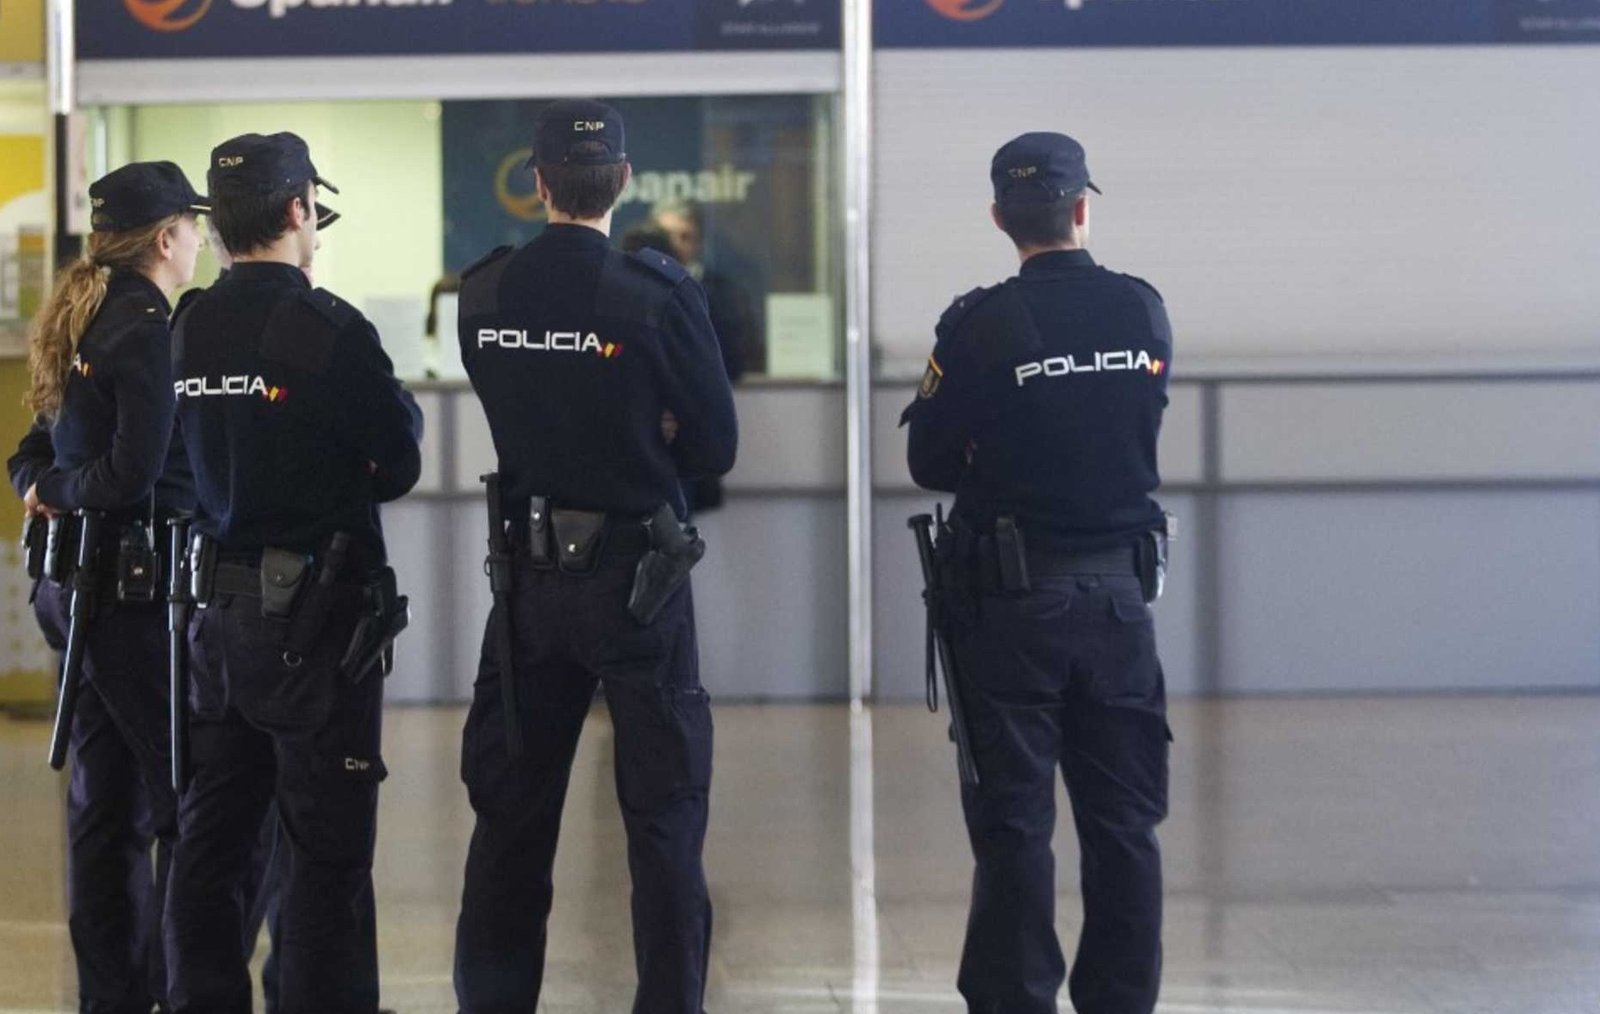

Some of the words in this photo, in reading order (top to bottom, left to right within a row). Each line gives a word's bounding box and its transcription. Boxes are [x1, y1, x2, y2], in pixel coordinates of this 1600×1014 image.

[573, 120, 605, 131] CNP
[218, 156, 244, 167] CNP
[1008, 165, 1037, 178] CNP
[477, 328, 603, 353] POLICIA
[1014, 350, 1151, 386] POLICIA
[173, 375, 269, 401] POLICIA
